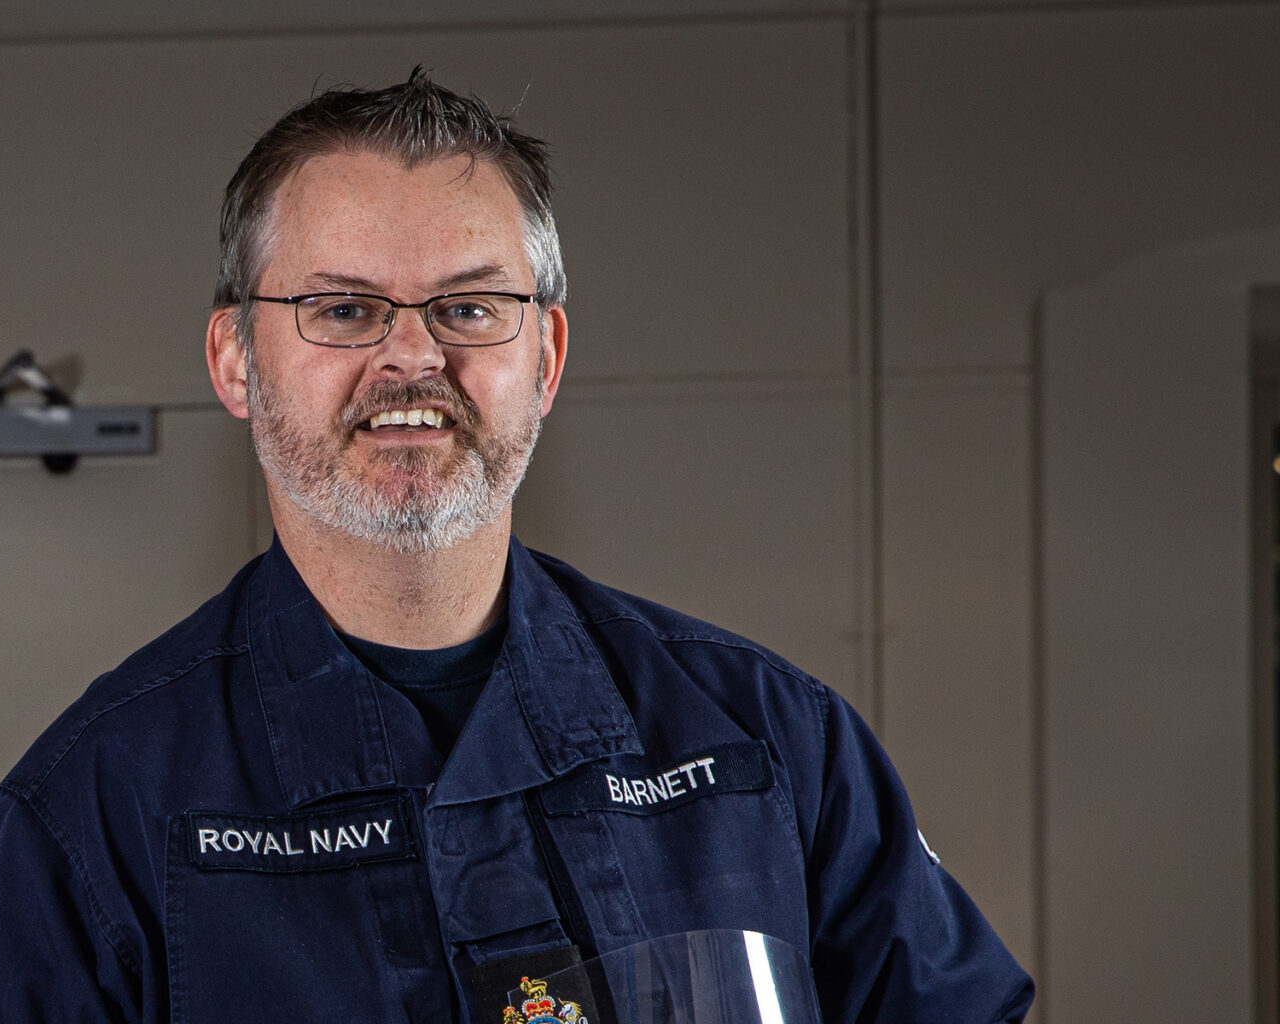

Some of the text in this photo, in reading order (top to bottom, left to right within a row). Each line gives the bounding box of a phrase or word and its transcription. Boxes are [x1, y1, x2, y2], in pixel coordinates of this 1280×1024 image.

[607, 757, 716, 807] BARNETT
[197, 818, 394, 856] ROYAL NAVY
